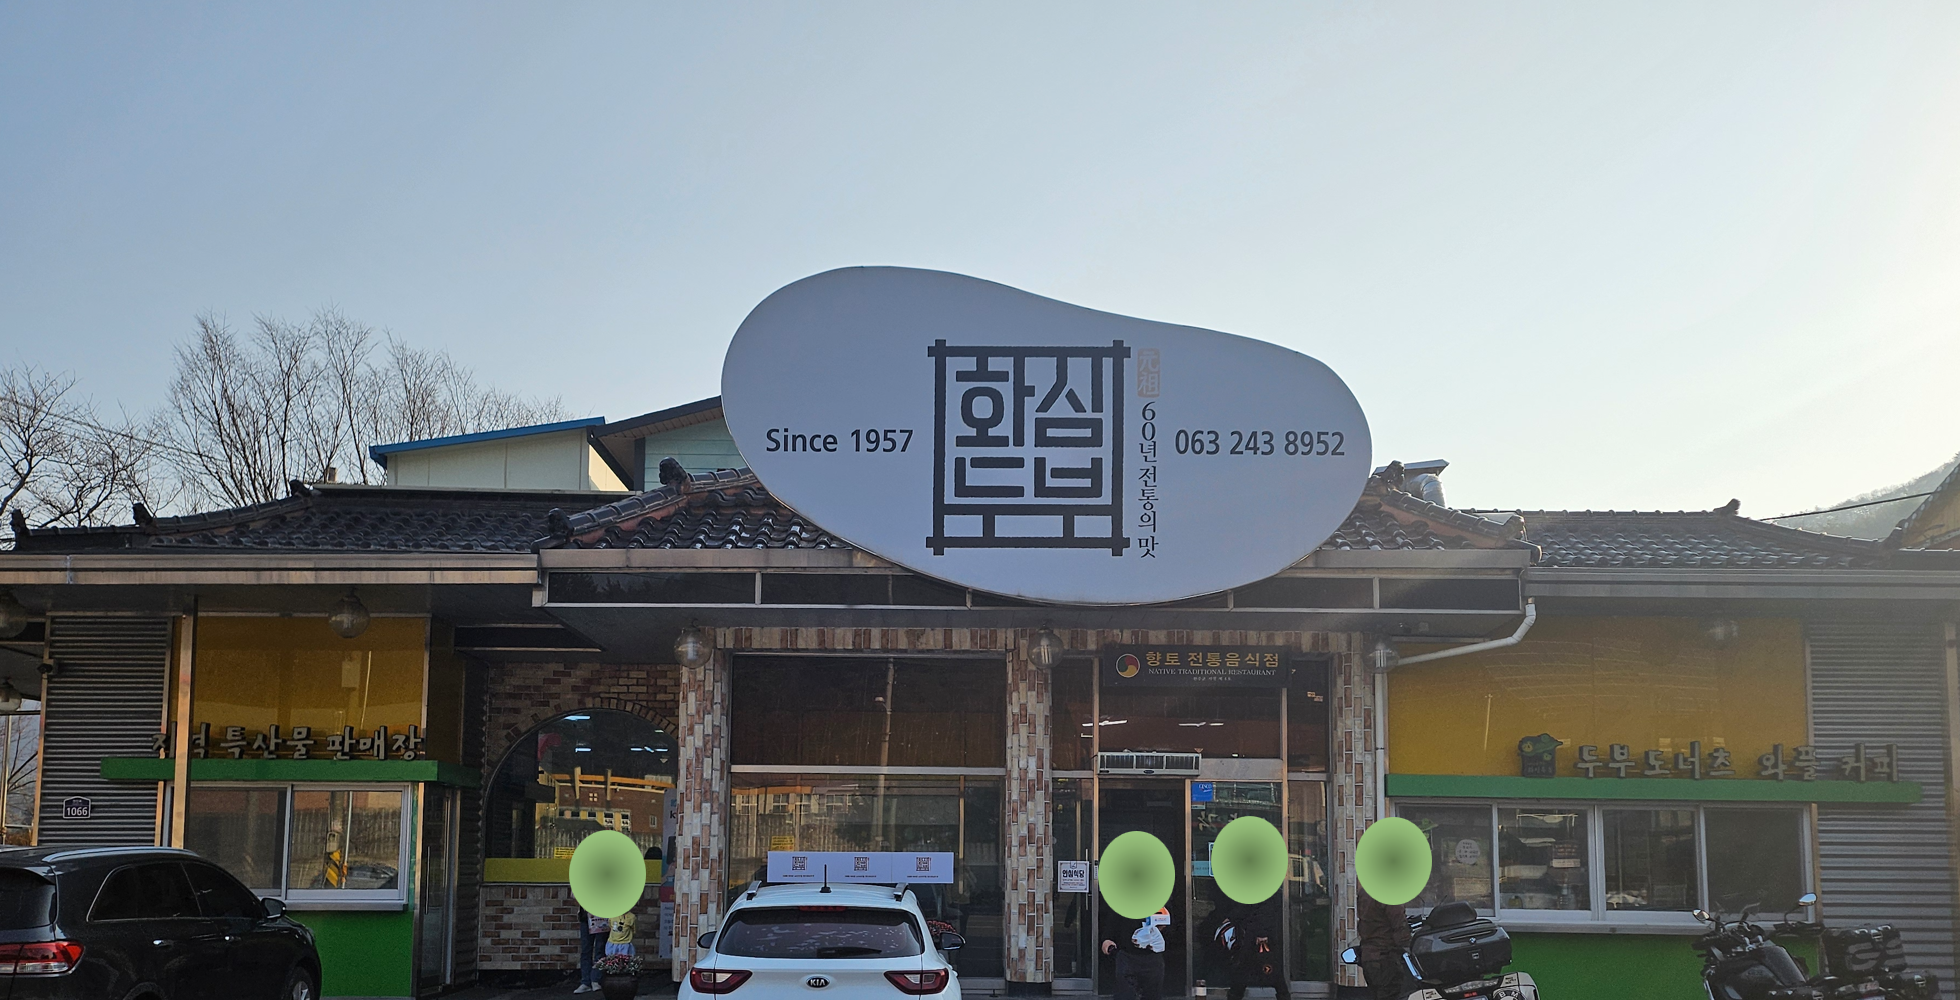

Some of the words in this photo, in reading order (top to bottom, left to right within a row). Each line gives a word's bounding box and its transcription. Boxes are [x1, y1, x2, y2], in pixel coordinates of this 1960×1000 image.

[1139, 351, 1160, 395] 元祖
[956, 354, 1105, 447] 화심
[767, 428, 837, 452] Since
[851, 429, 913, 452] 1957
[1176, 430, 1219, 454] 063
[1230, 431, 1274, 455] 243
[1285, 431, 1344, 455] 8952
[1145, 651, 1181, 667] 향토
[1187, 651, 1280, 668] 전통음식점
[220, 723, 315, 760] 특산물
[325, 724, 424, 761] 판매장
[1575, 740, 1736, 781] 두부도너츠
[1757, 743, 1821, 781] 와플
[1839, 742, 1899, 782] 커피
[66, 806, 88, 816] 1066
[809, 978, 826, 986] KIA
